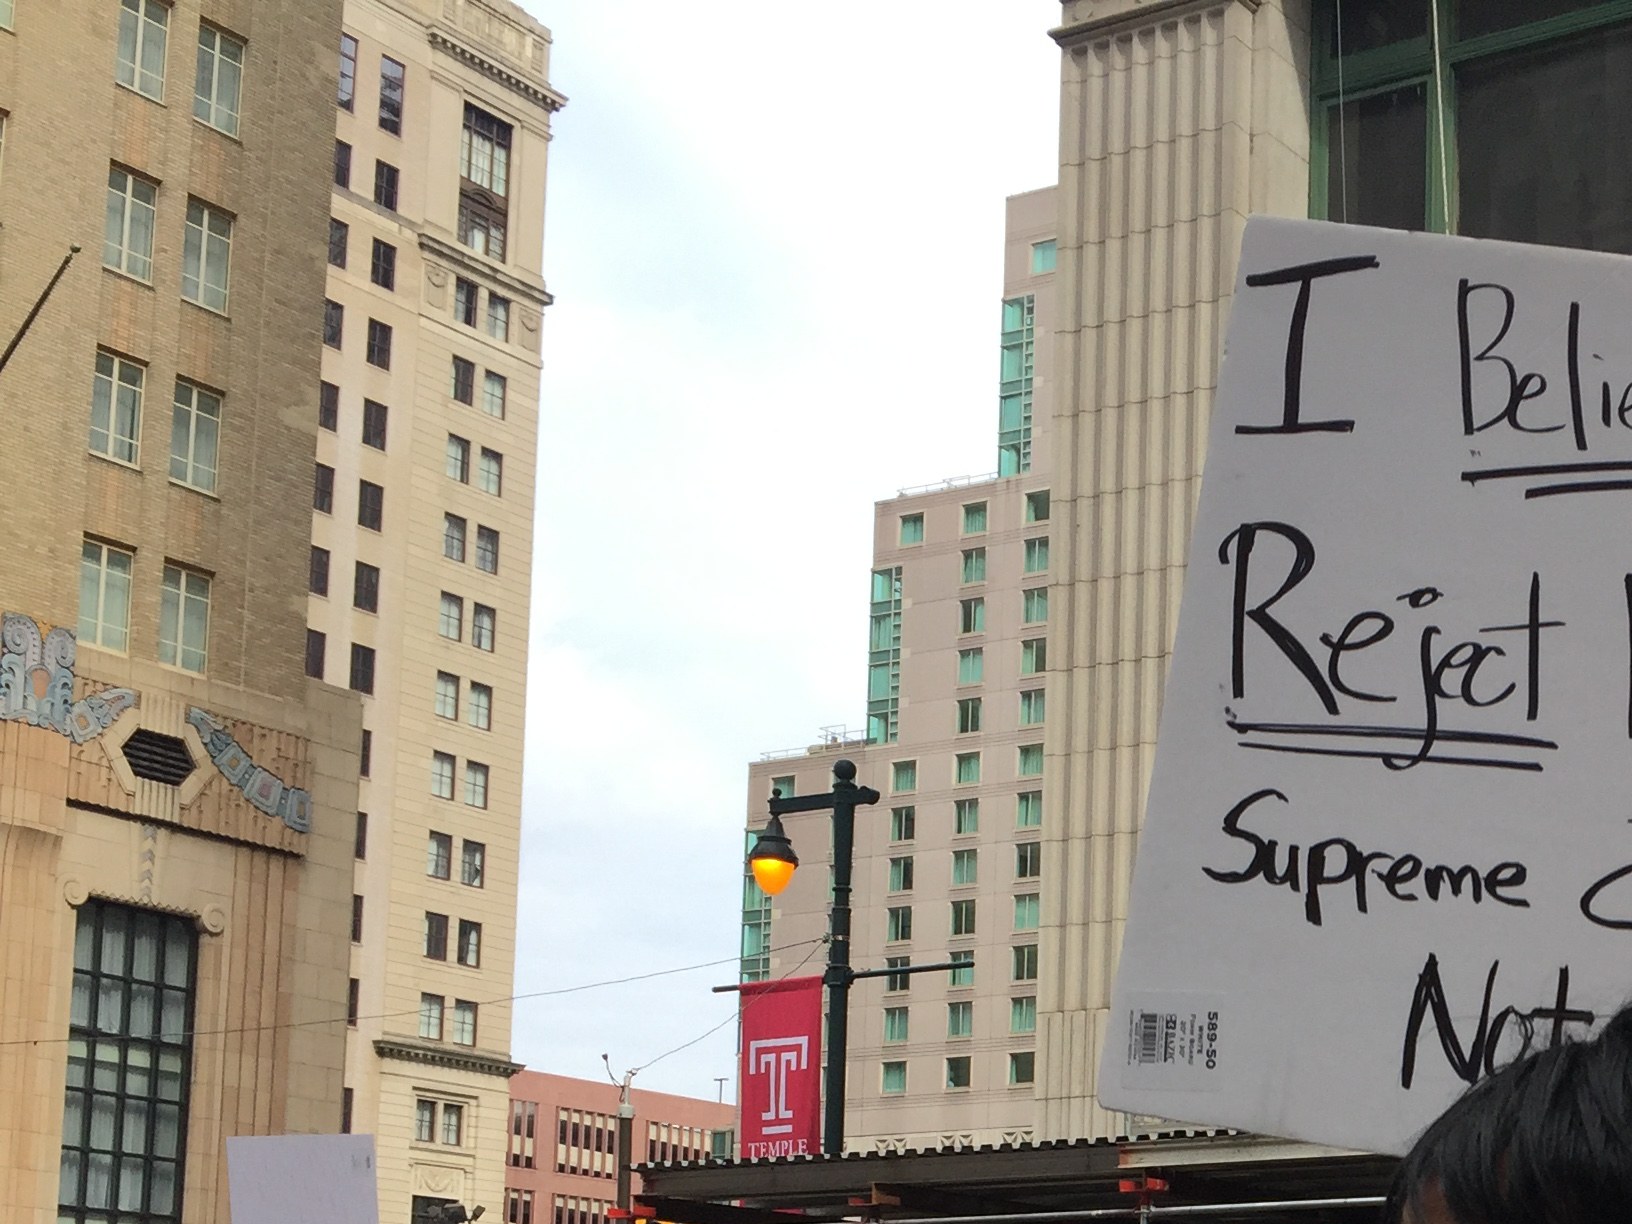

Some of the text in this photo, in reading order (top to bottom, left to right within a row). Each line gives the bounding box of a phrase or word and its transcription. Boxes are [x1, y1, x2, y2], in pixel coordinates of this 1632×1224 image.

[1235, 254, 1380, 435] I
[1217, 520, 1566, 770] Reject
[1201, 788, 1531, 926] Supreme
[1205, 1011, 1219, 1070] 589-50
[747, 1138, 809, 1159] TEMPLE
